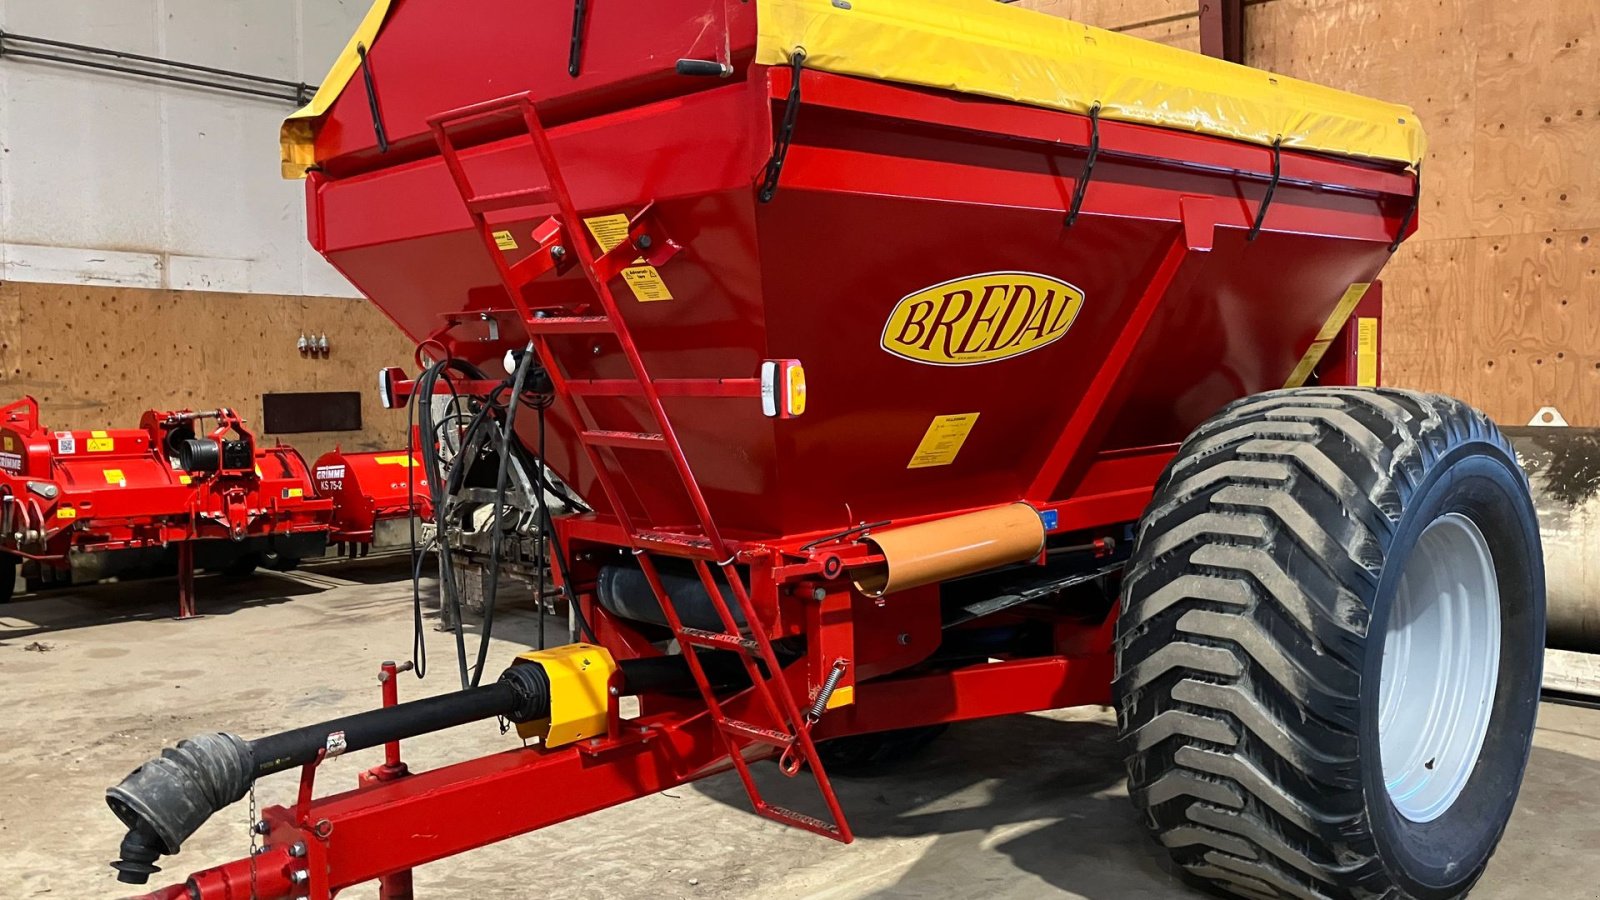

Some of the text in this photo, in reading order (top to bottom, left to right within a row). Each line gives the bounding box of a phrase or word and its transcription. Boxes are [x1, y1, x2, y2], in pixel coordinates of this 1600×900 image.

[895, 285, 1072, 358] BREDAL
[317, 469, 345, 479] GRIMME
[321, 480, 342, 490] KS 75-2
